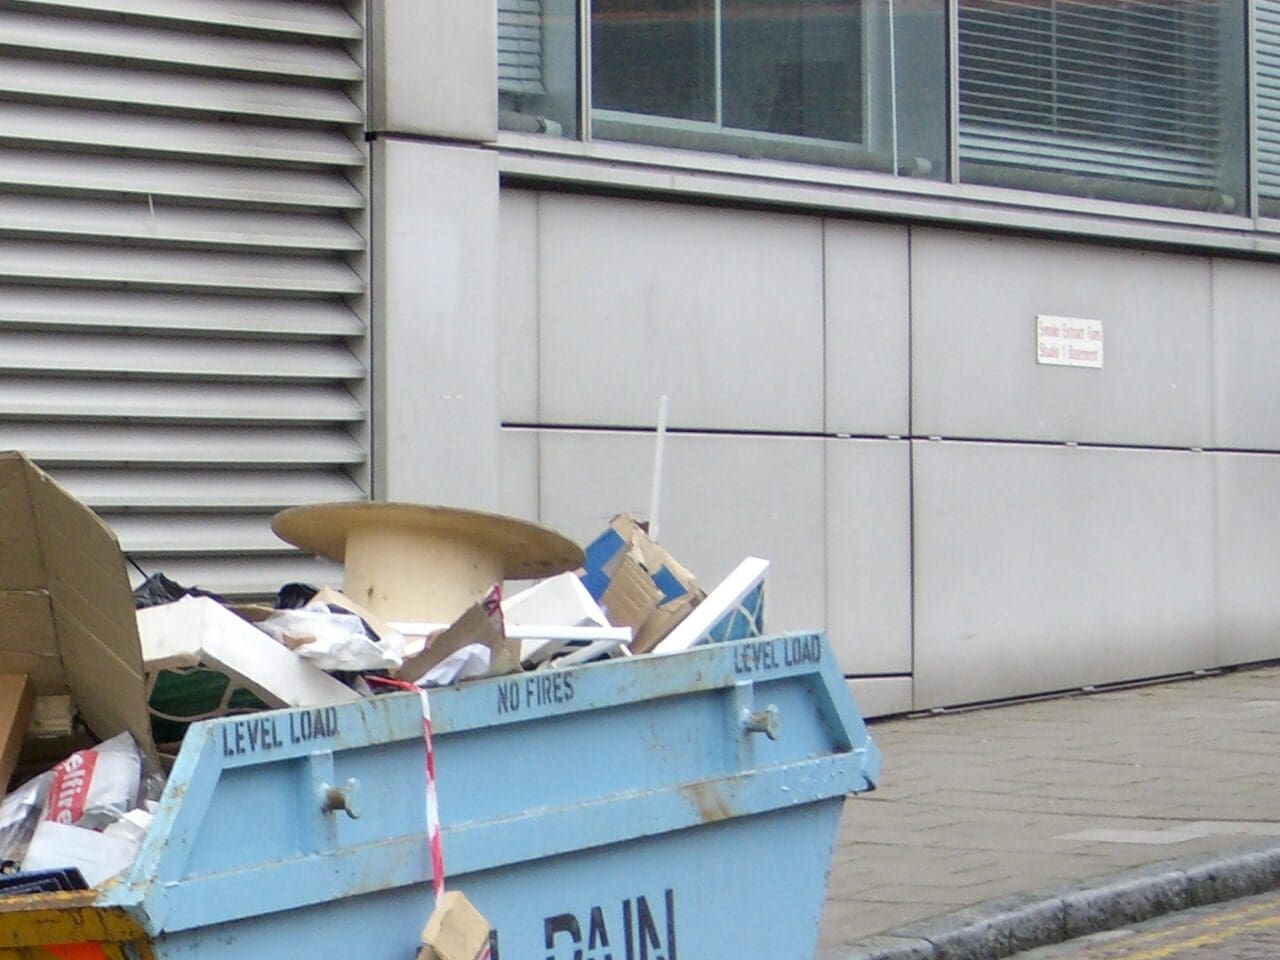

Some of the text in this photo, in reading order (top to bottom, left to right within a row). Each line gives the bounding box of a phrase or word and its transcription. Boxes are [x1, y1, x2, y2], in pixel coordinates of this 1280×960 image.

[734, 634, 821, 674] LEVEL LOAD
[497, 671, 574, 714] NO FIRES
[222, 706, 338, 757] LEVEL LOAD
